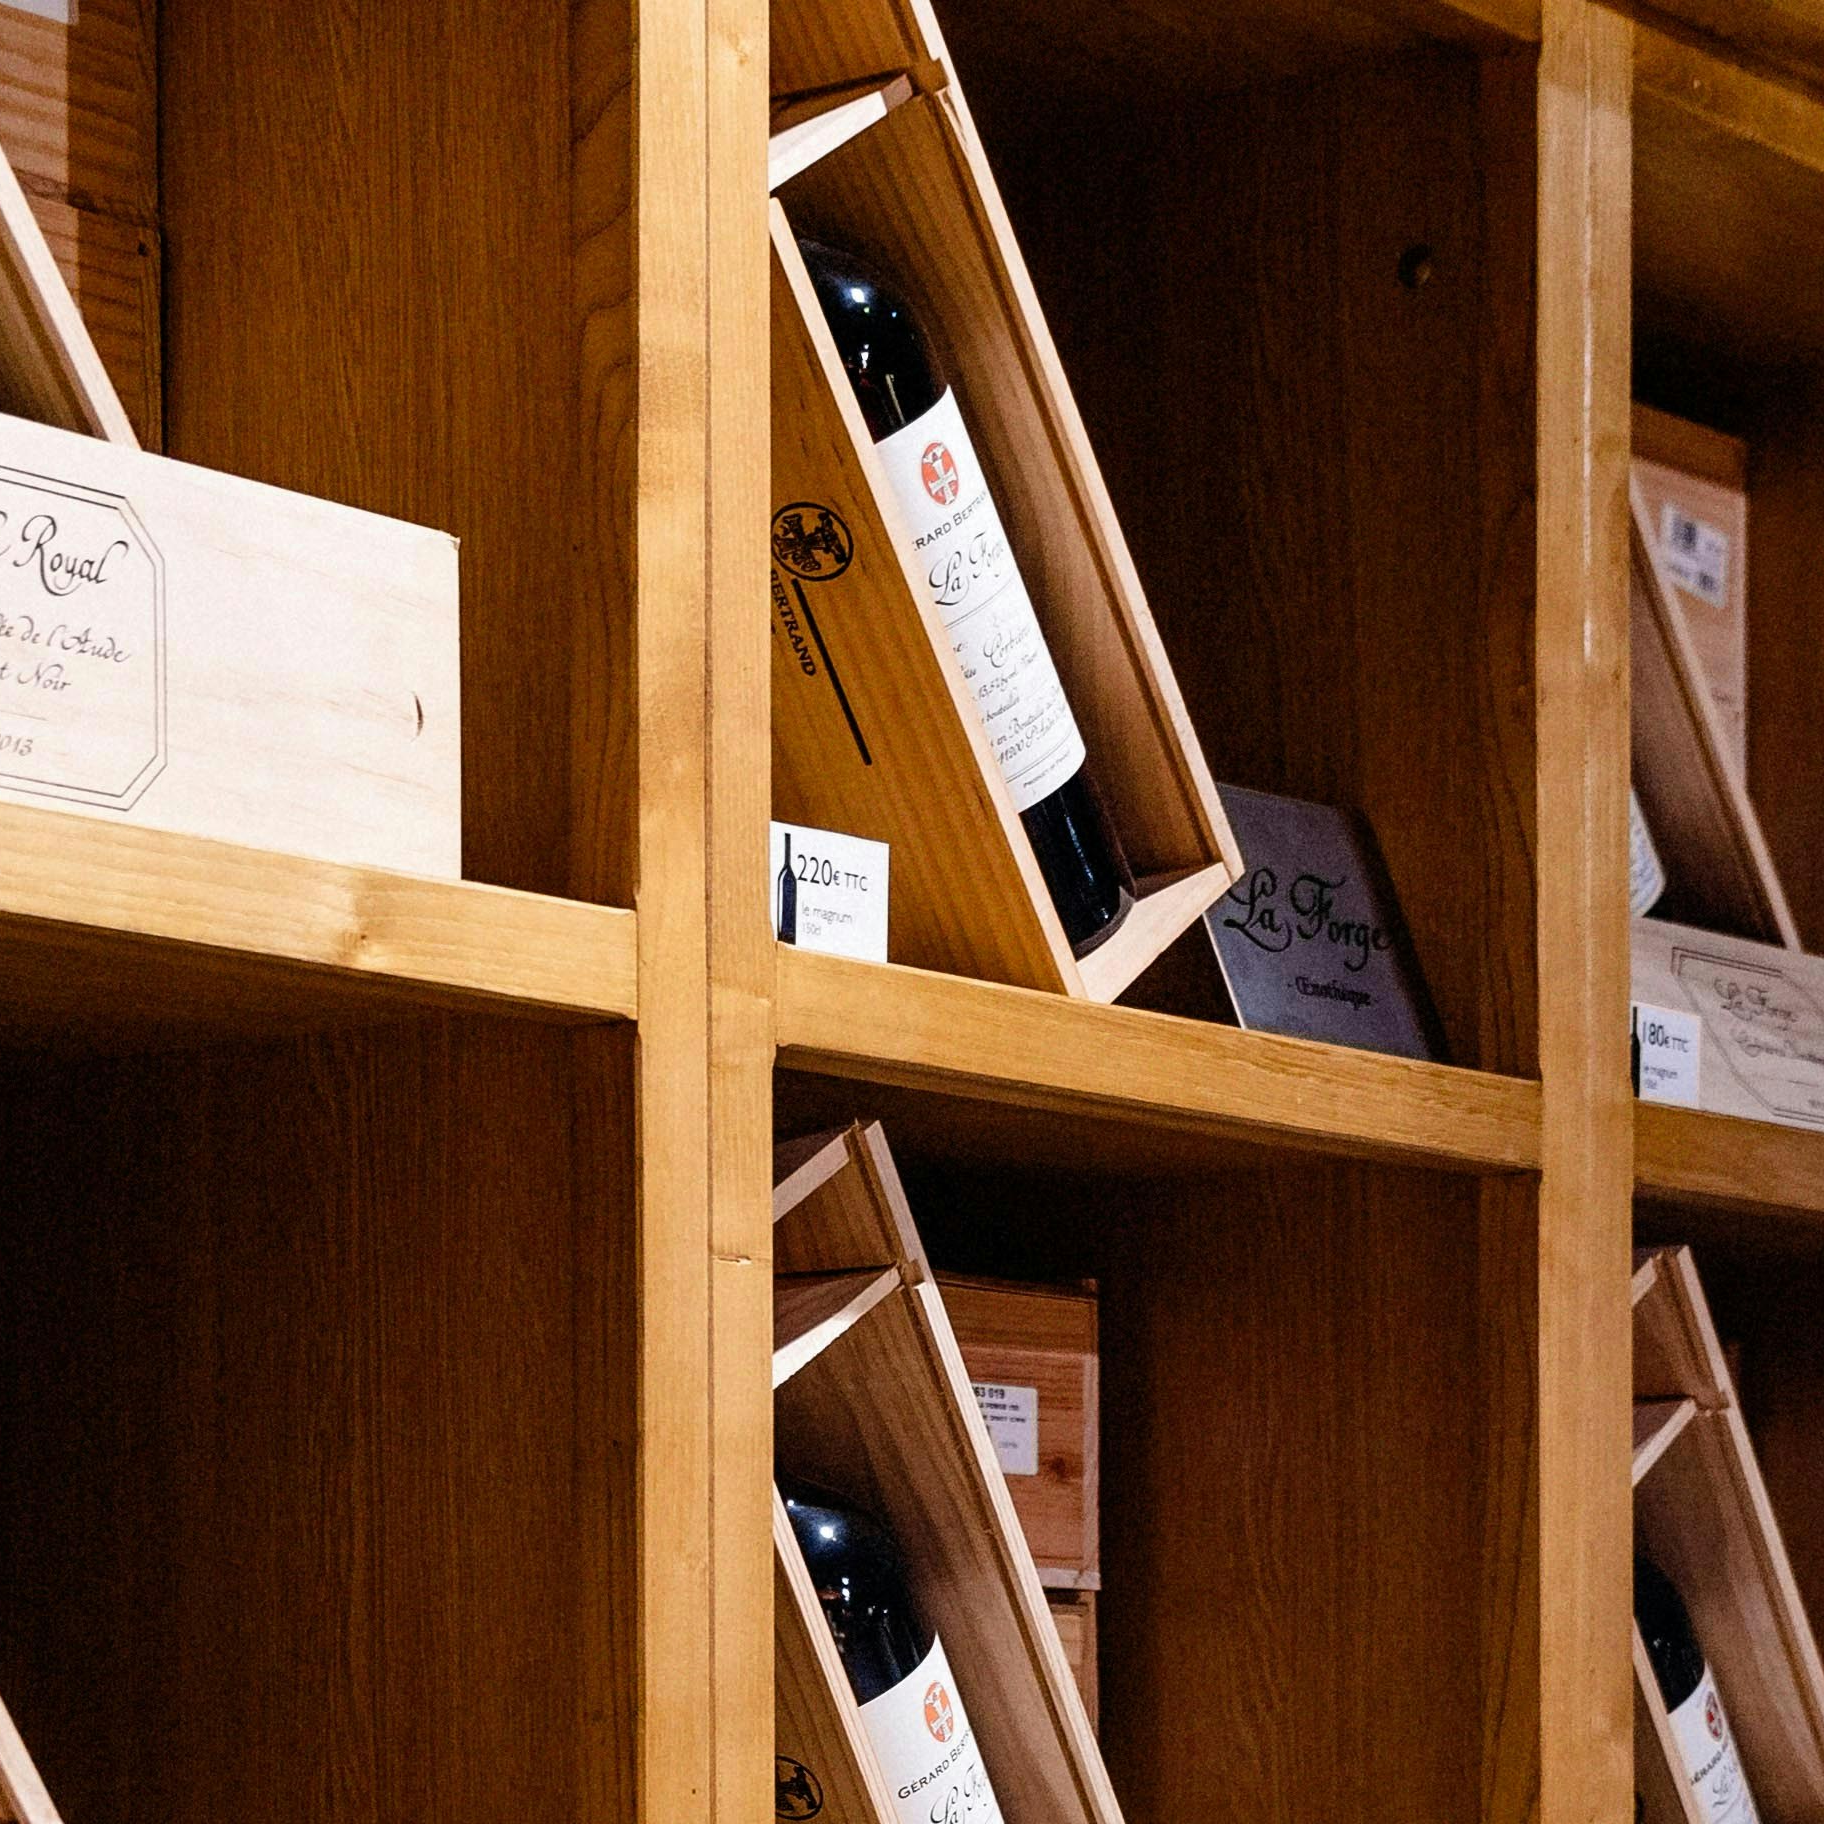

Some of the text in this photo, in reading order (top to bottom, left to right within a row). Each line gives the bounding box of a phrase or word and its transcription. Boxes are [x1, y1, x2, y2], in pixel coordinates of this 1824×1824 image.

[12, 514, 130, 597] Royal
[928, 550, 971, 606] La
[19, 614, 41, 646] de
[17, 663, 72, 693] Noir
[797, 853, 869, 892] 220€ TTC
[1223, 867, 1395, 972] La Forge
[1642, 1021, 1670, 1048] 180€
[898, 1759, 950, 1800] GÉRARD
